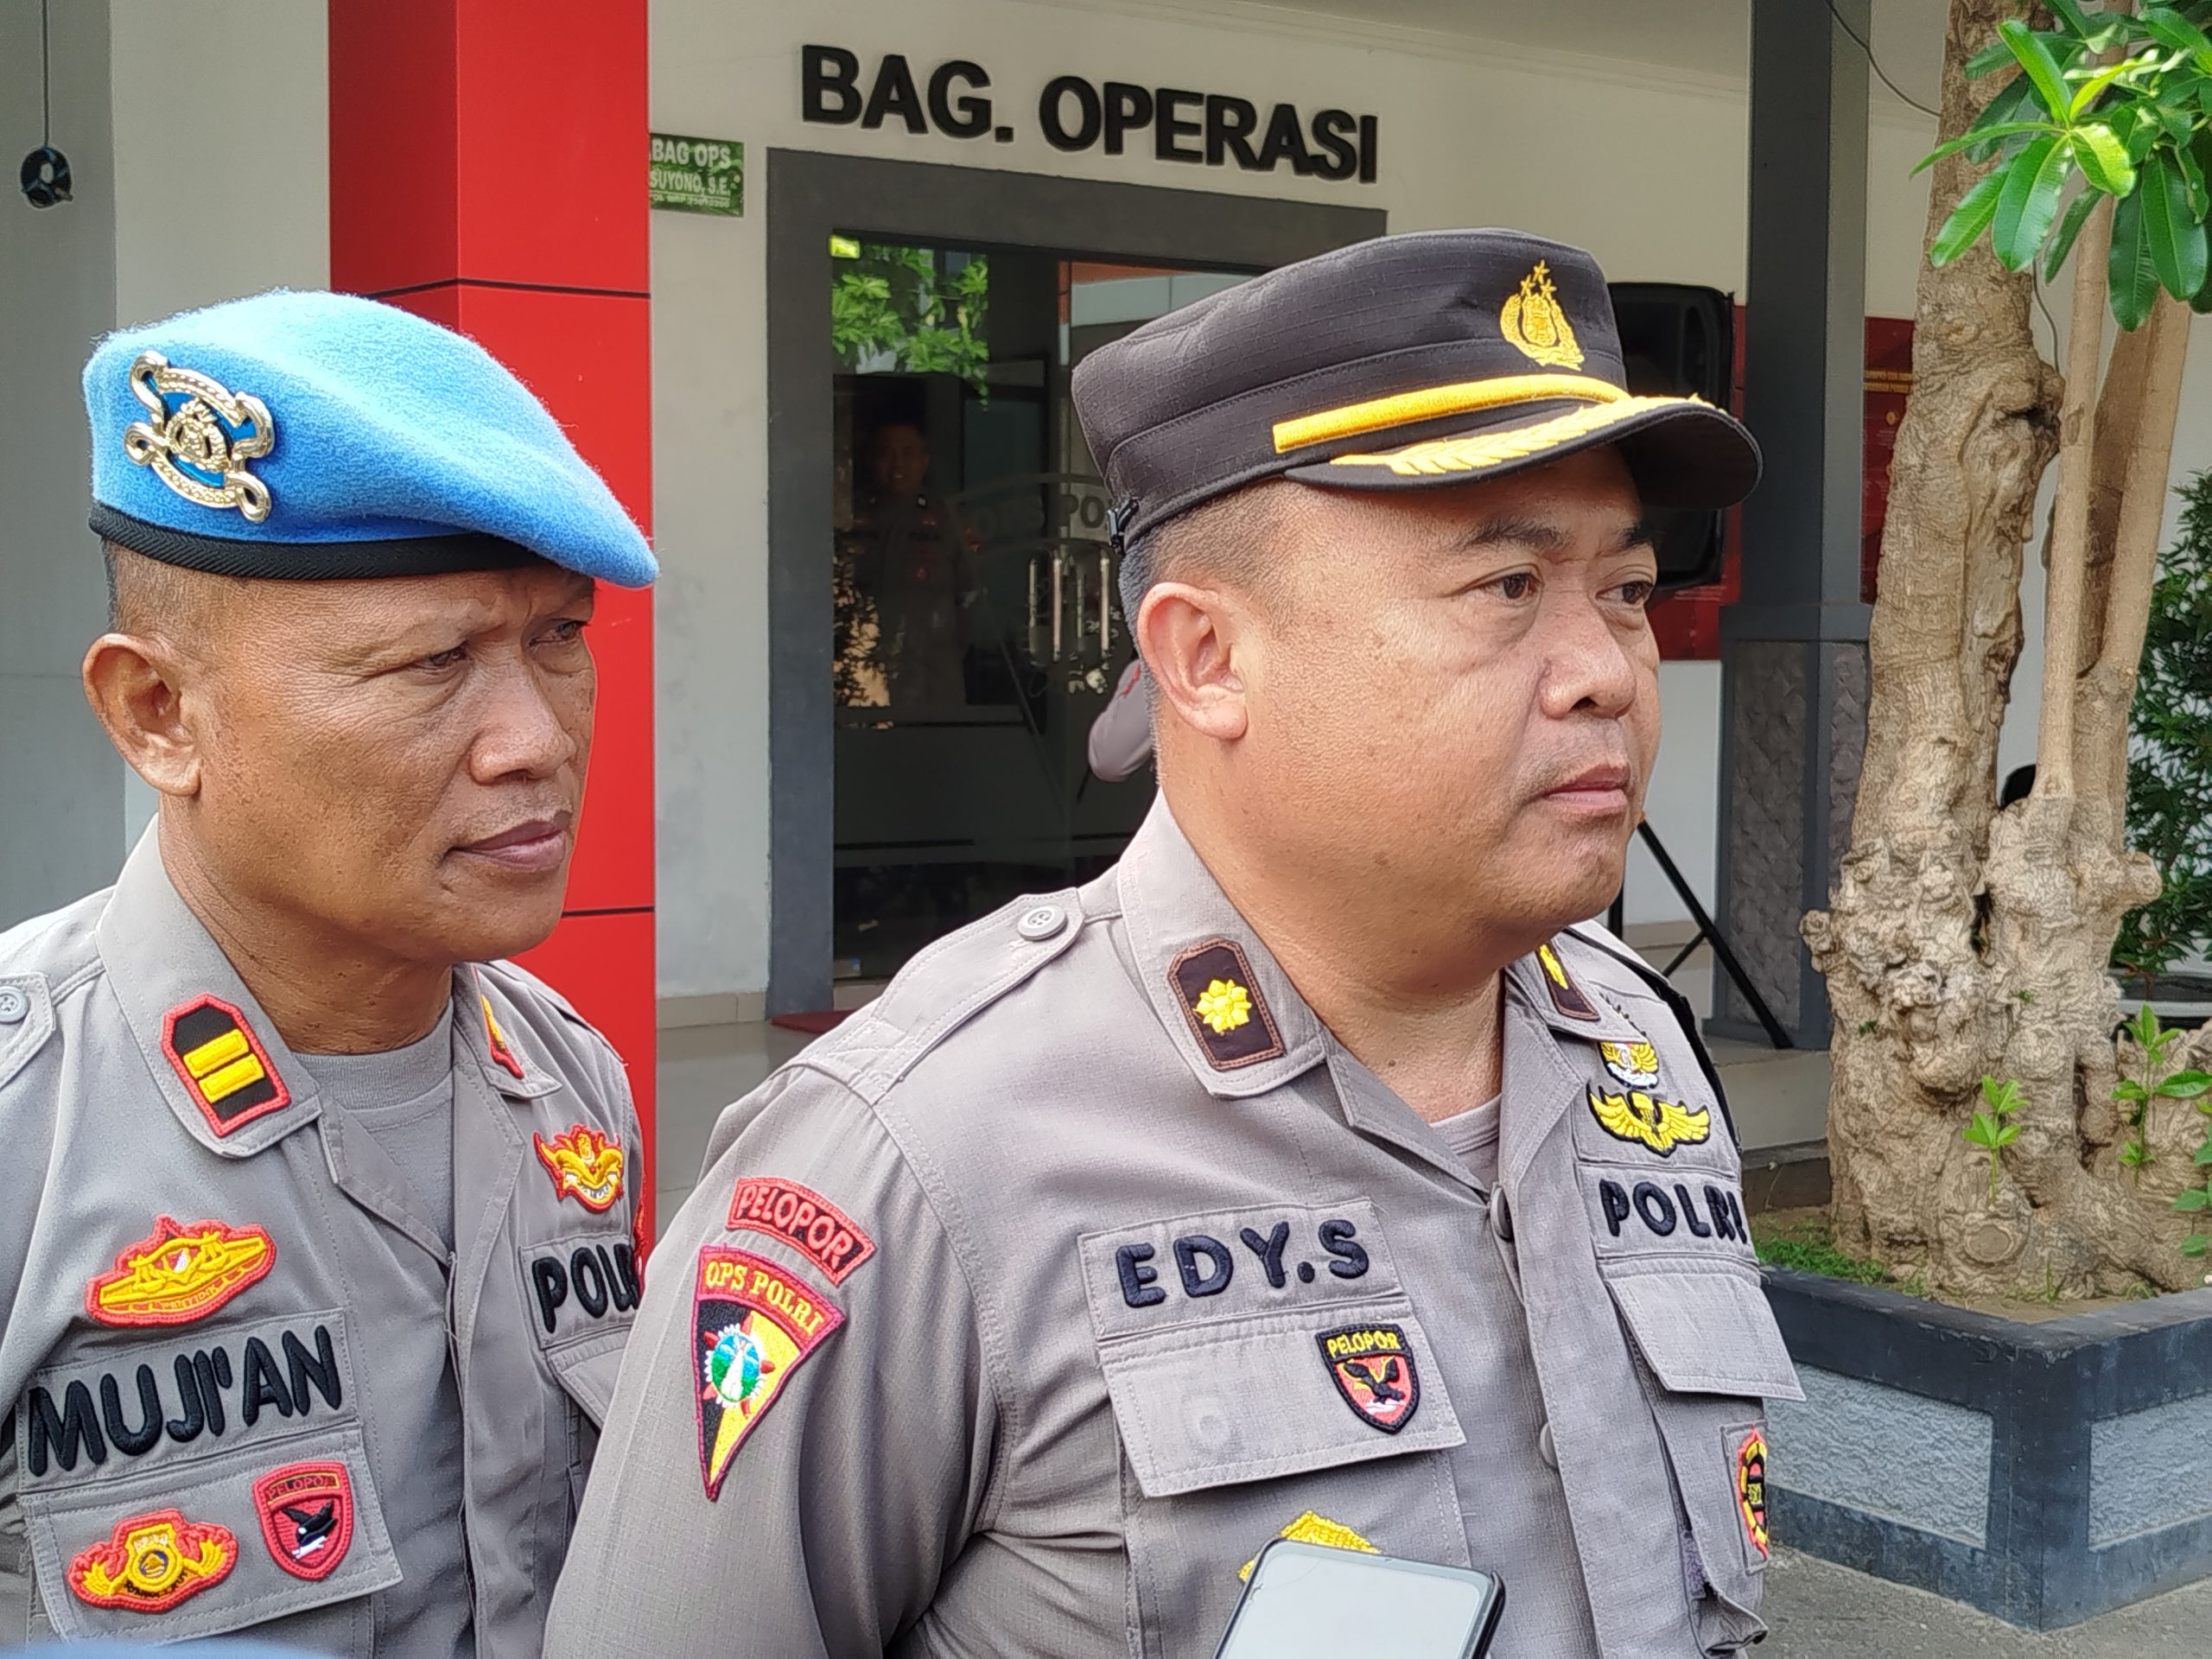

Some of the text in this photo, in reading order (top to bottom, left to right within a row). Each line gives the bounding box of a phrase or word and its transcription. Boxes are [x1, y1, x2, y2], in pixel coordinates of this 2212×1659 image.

[650, 138, 731, 169] BAG OPS
[802, 44, 1377, 183] BAG. OPERASI
[736, 1185, 853, 1270] PELOPOR
[1599, 1179, 1747, 1244] POLRI
[705, 1261, 824, 1336] OPS POLRI
[1116, 1219, 1370, 1308] EDY.S
[1327, 1331, 1402, 1358] PELOPOR
[29, 1325, 342, 1477] MUJI'AN
